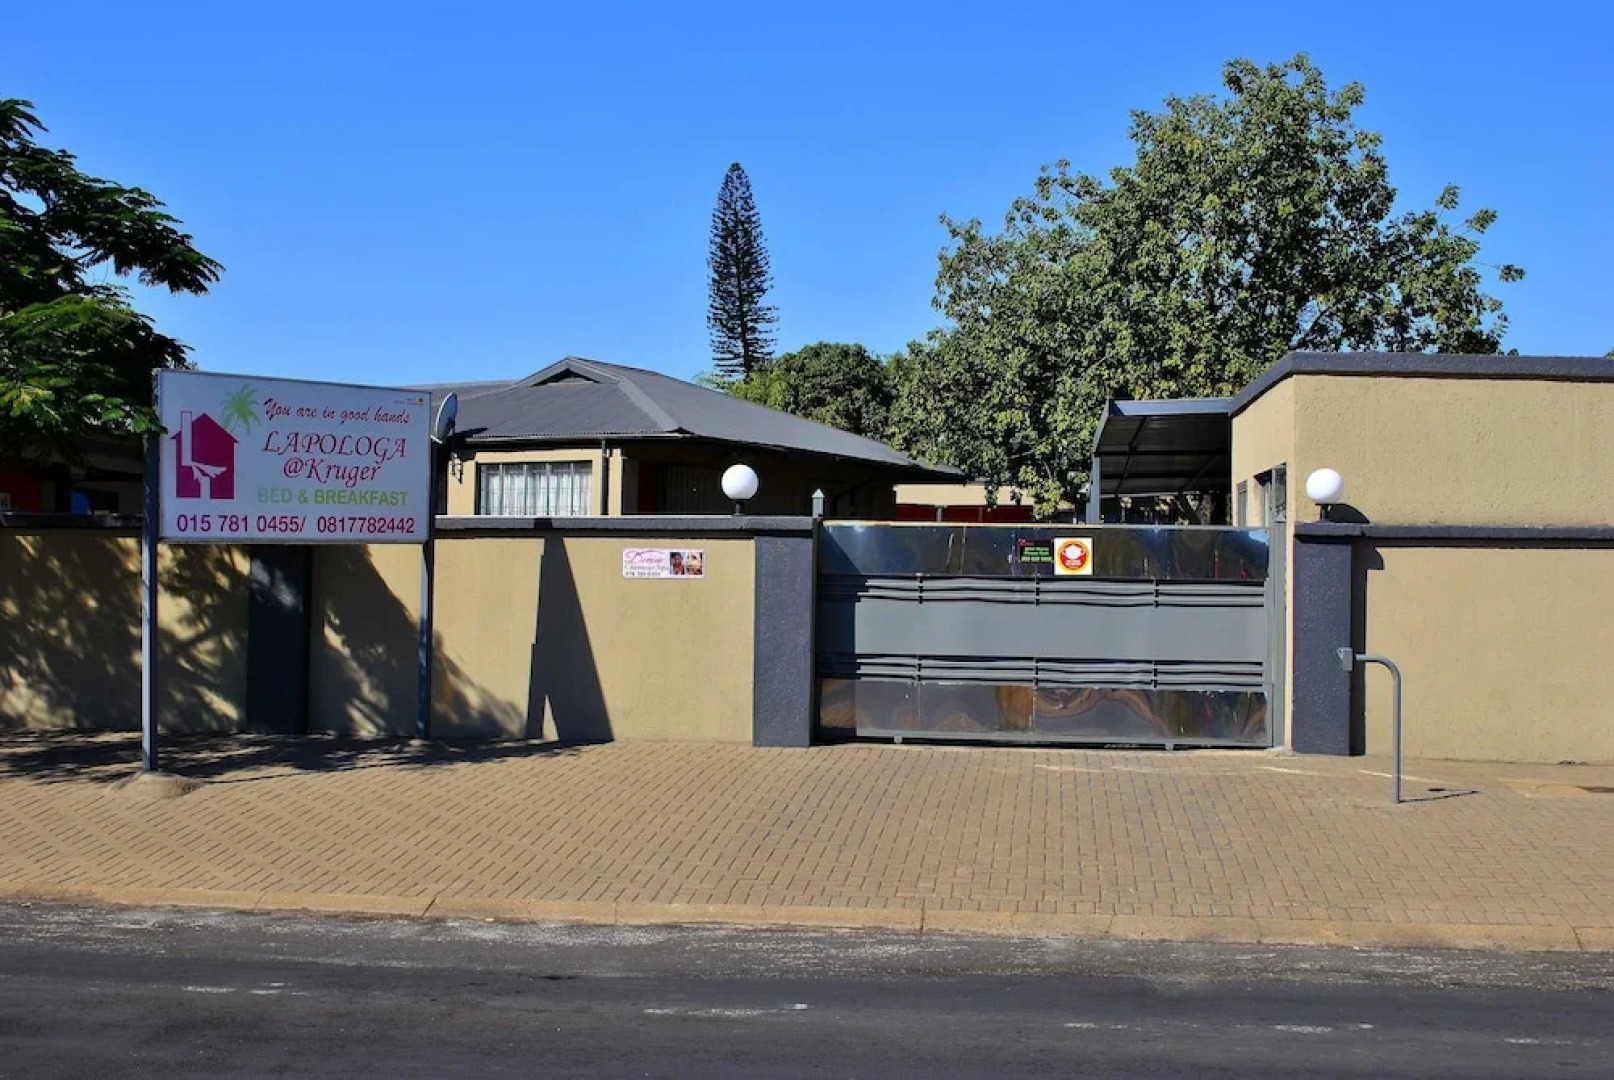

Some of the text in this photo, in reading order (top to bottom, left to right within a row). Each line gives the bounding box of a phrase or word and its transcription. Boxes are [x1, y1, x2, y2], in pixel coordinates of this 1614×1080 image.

[264, 398, 412, 425] You are in good hands
[262, 430, 407, 464] LAPOLOGA
[283, 457, 382, 488] @Kruger
[258, 488, 409, 506] BED & BREAKFAST
[176, 514, 416, 534] 015 781 0455/ 0817782442
